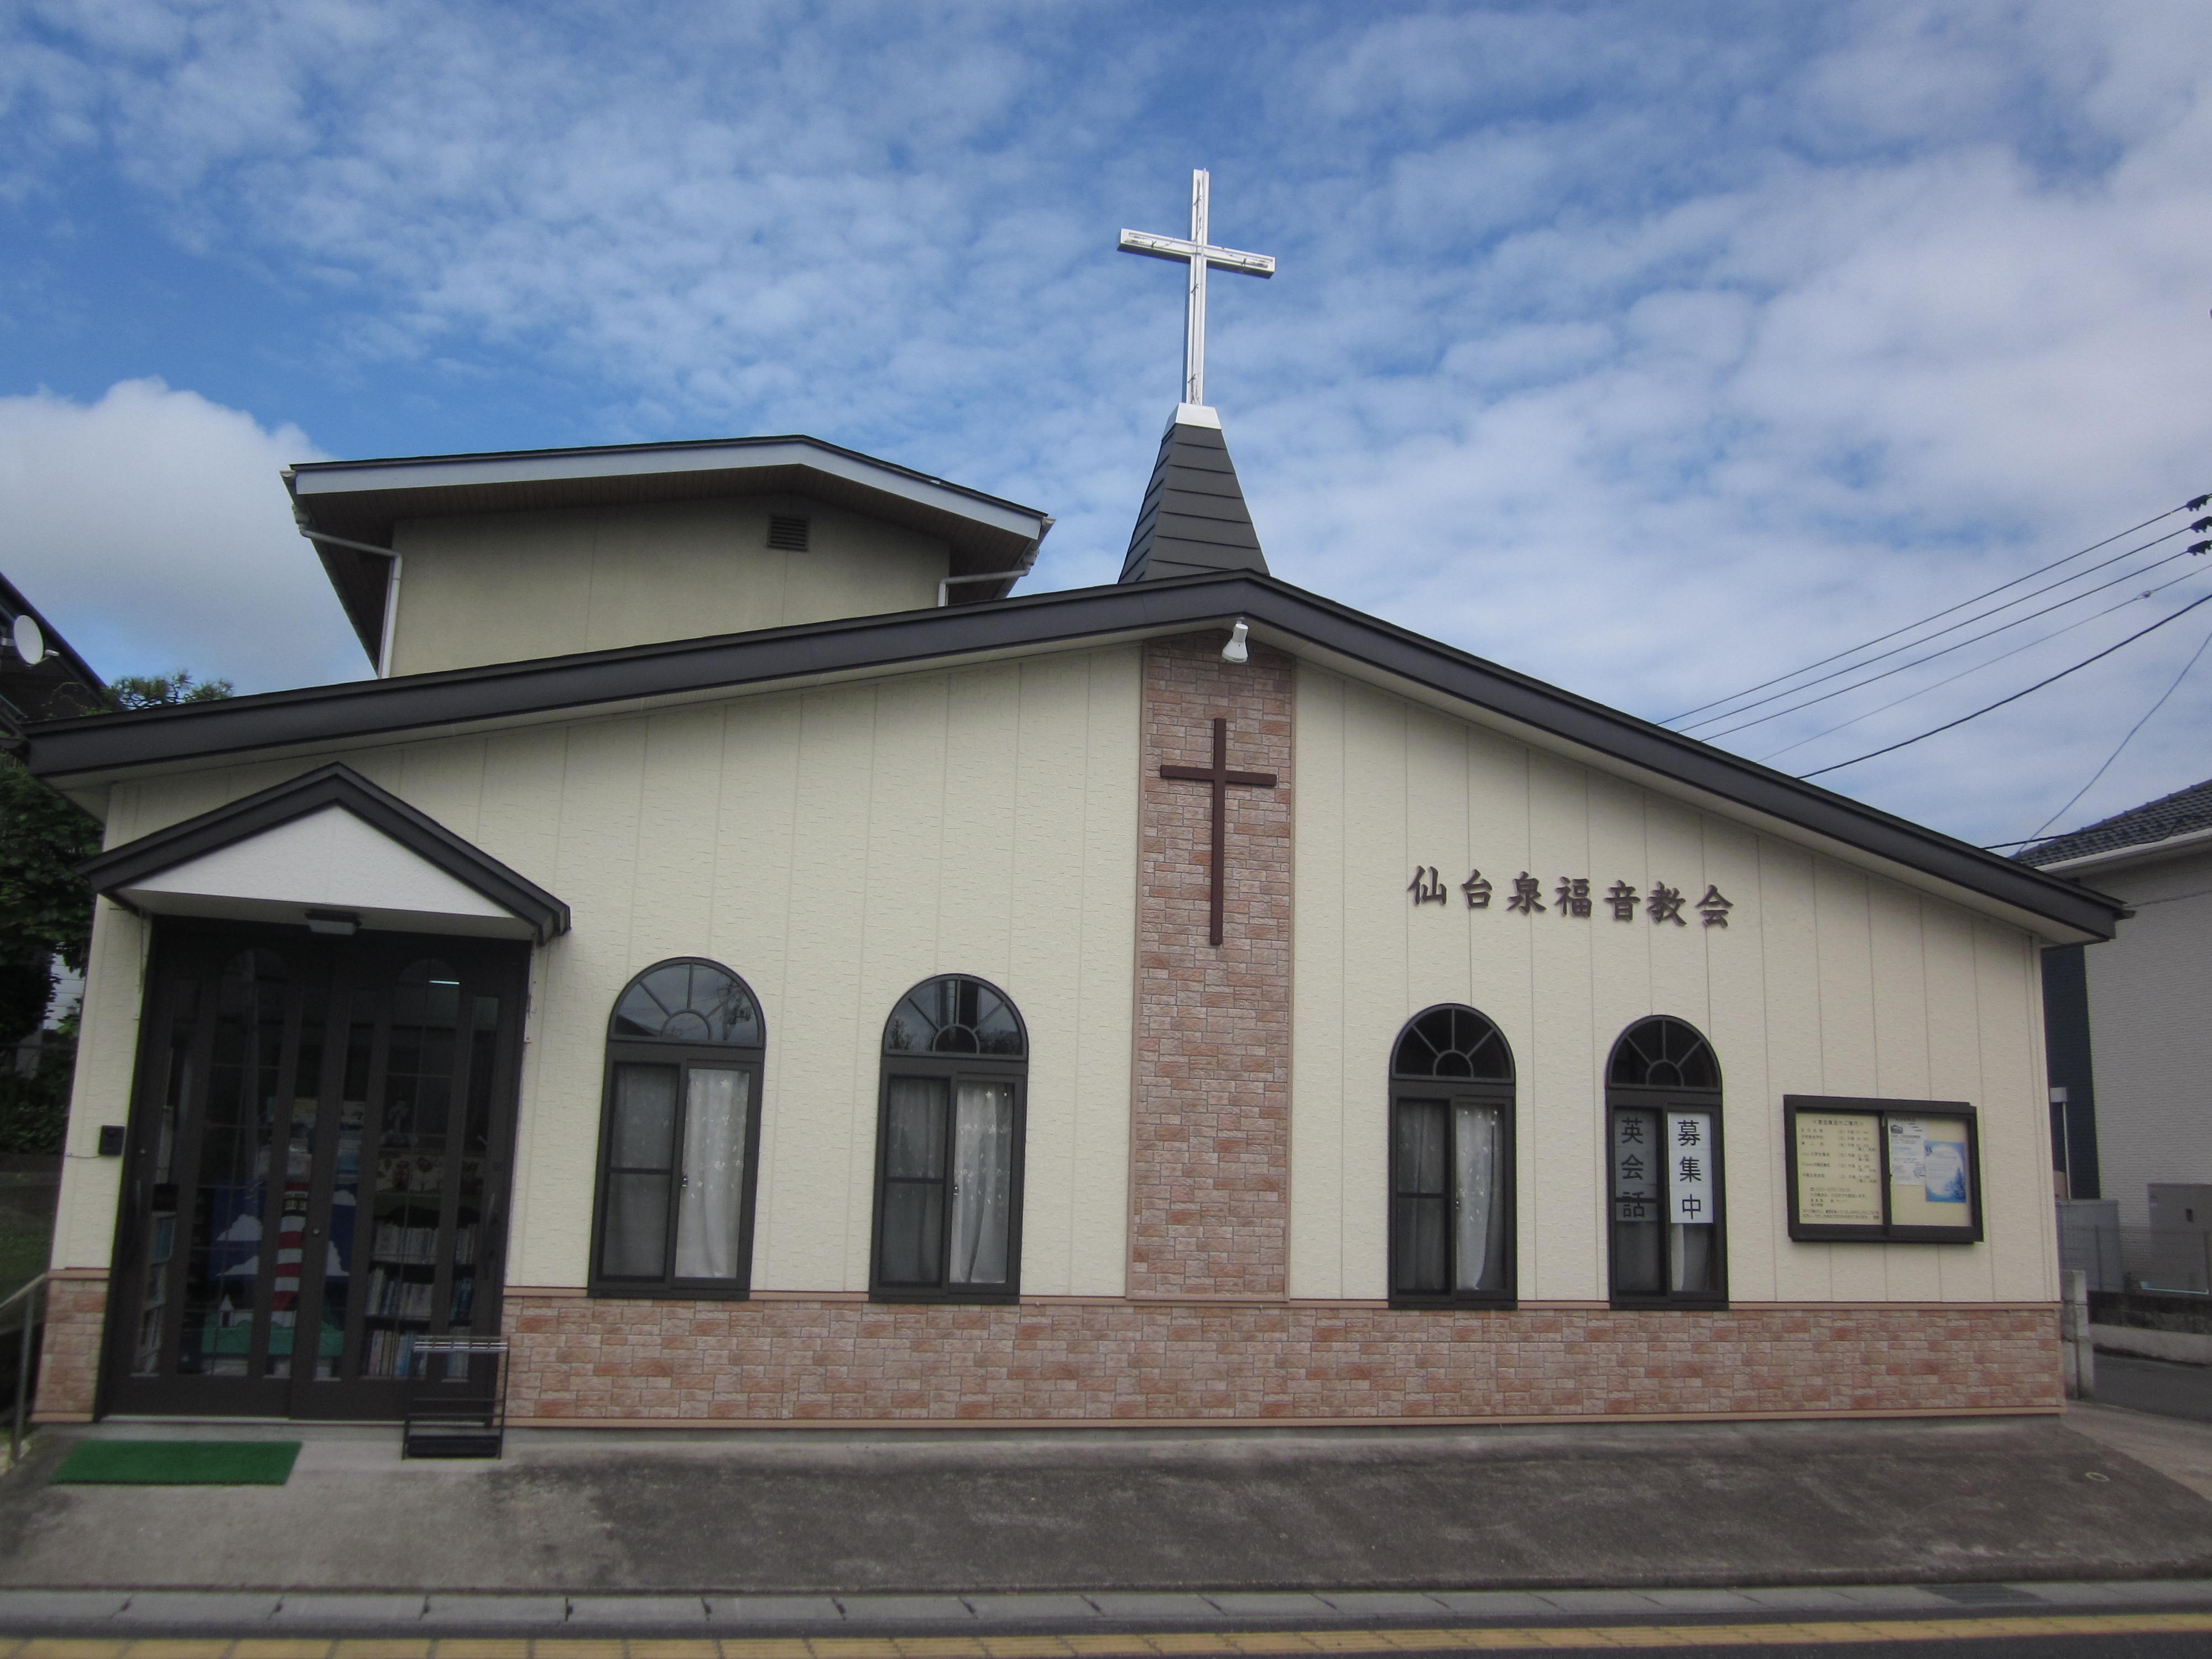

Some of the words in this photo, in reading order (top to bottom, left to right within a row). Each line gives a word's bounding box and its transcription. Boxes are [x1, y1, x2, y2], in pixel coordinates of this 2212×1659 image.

[1407, 865, 1735, 928] 仙台泉福音教会
[1621, 1117, 1646, 1218] 英会話
[1677, 1119, 1702, 1220] 募集中
